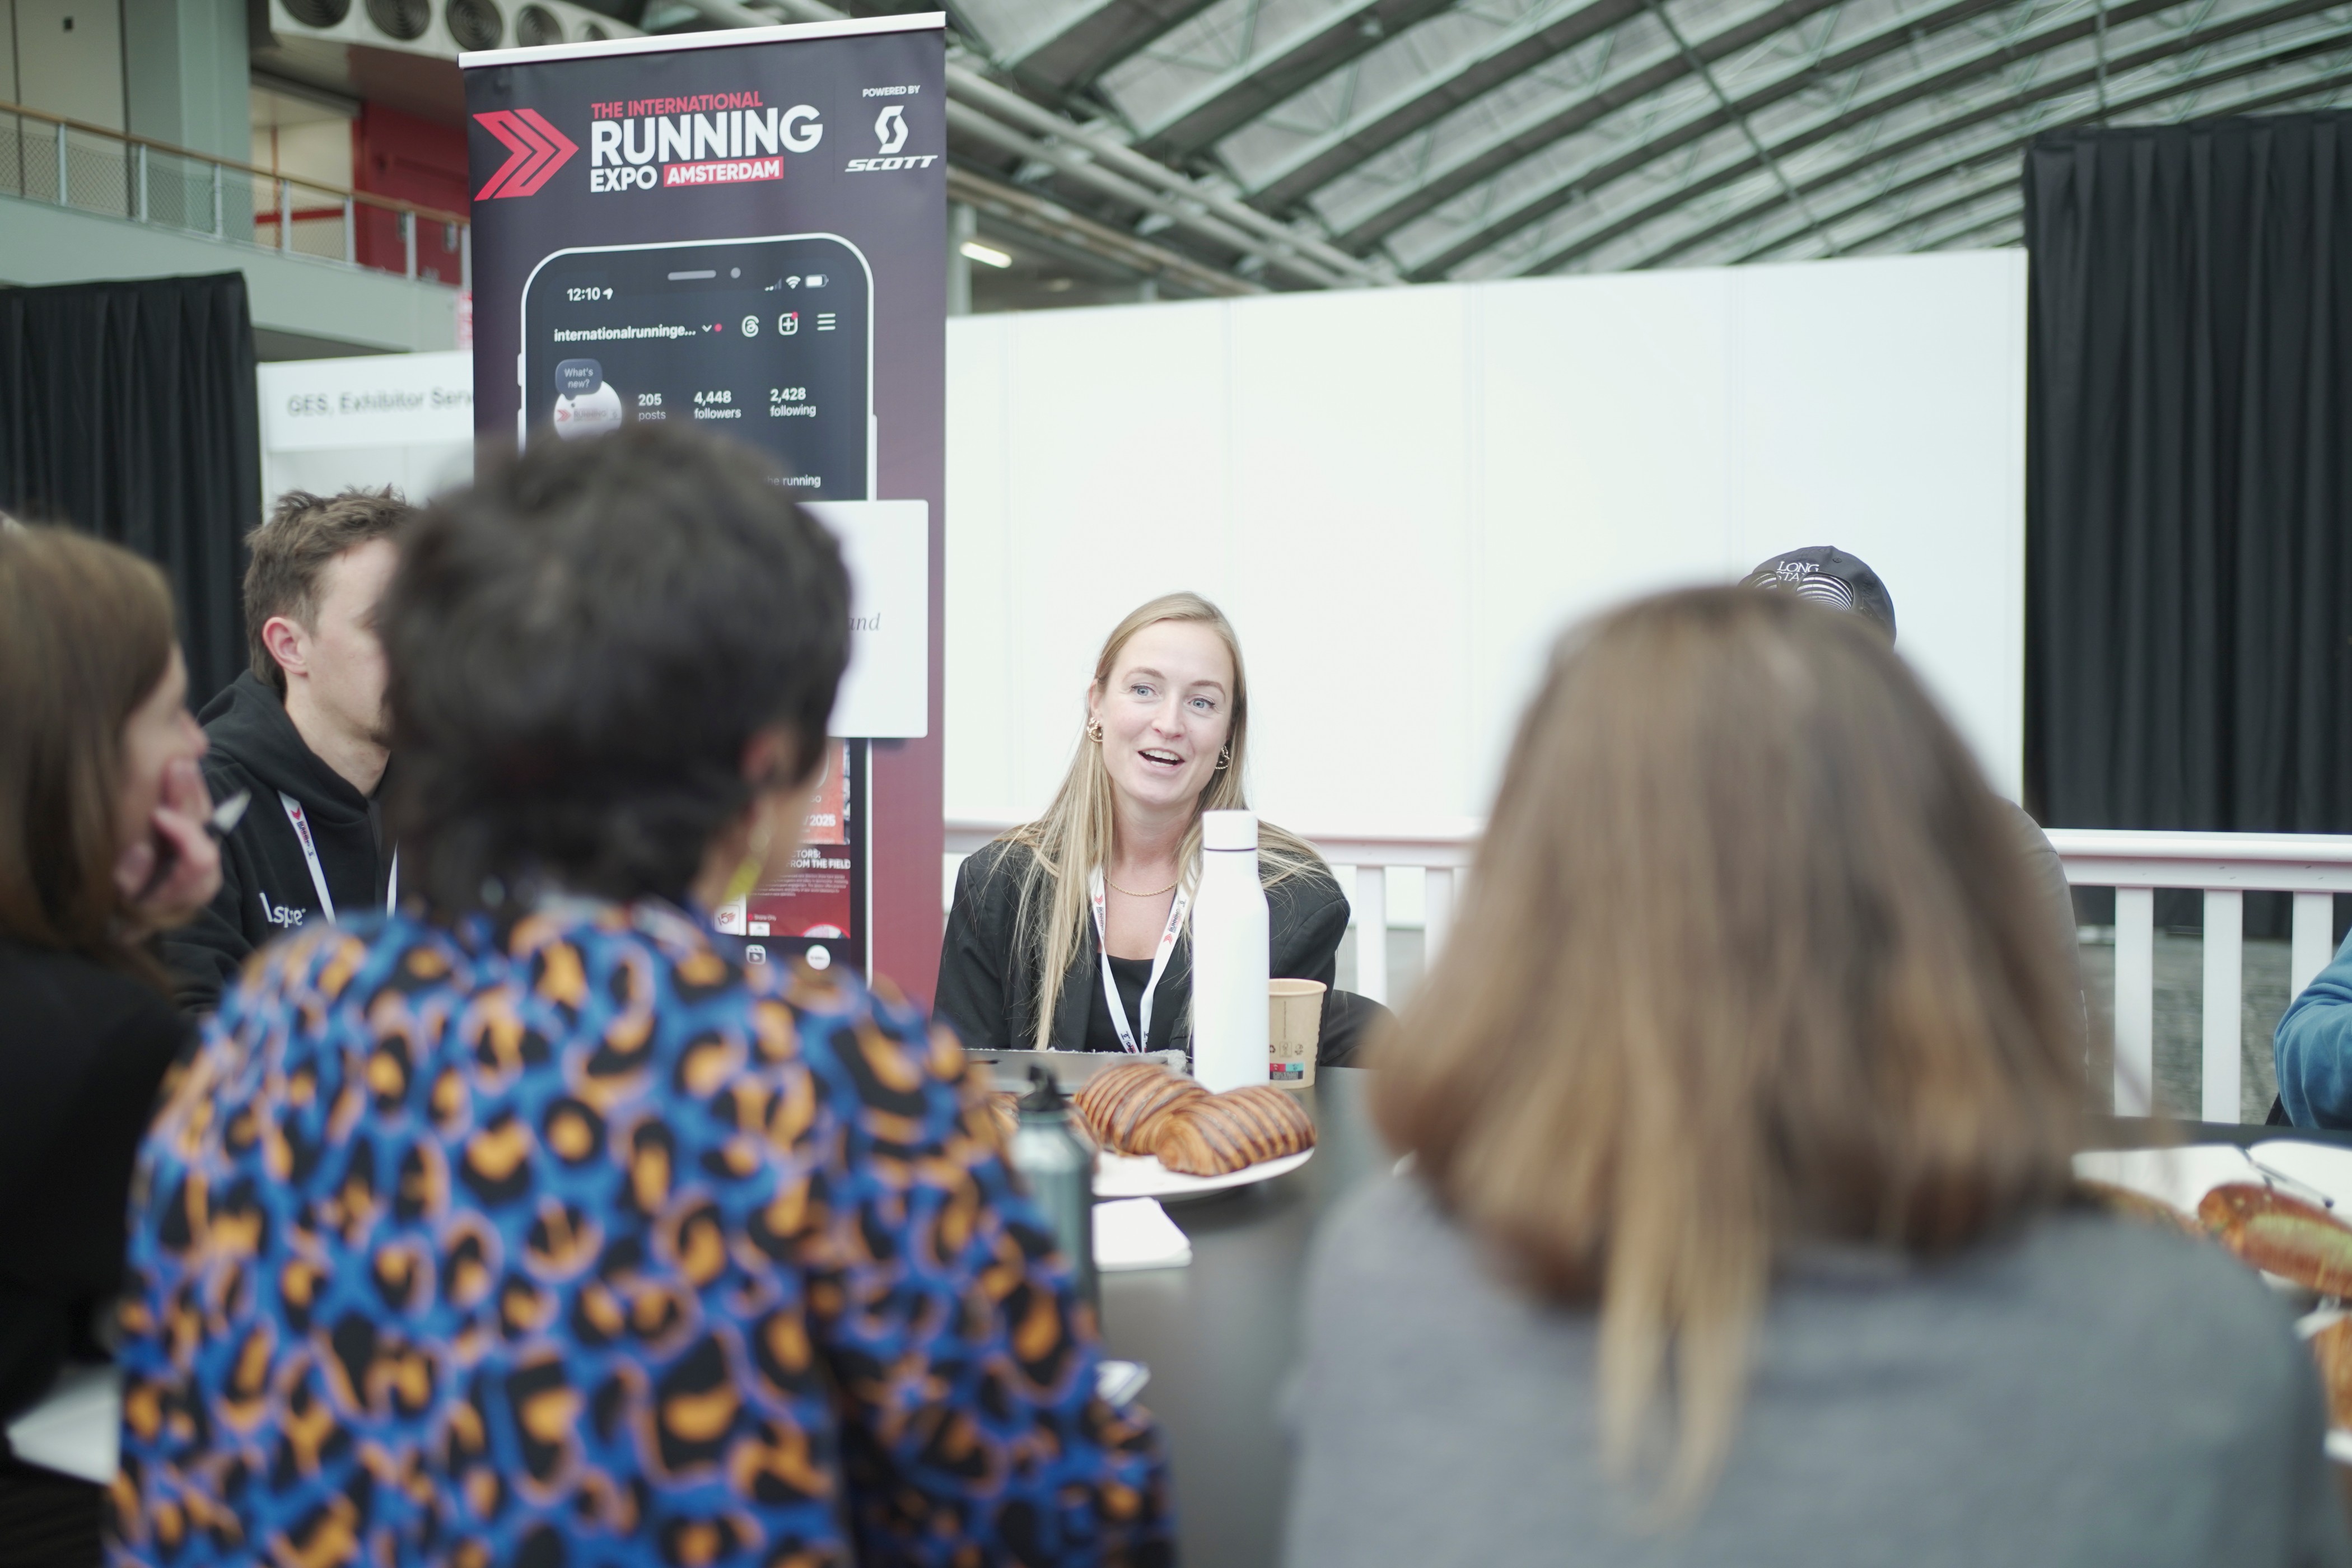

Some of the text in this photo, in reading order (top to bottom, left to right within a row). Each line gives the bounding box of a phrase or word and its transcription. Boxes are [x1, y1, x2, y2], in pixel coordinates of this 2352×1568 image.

[862, 85, 921, 97] POWERED BY
[591, 91, 763, 119] THE INTERNATIONAL
[591, 104, 823, 167] RUNNING
[844, 155, 938, 172] SCOTT
[590, 160, 780, 193] EXPO AMSTERDAM
[567, 287, 600, 301] 12:10
[564, 367, 594, 377] What's
[568, 379, 590, 389] new?
[340, 390, 424, 414] Exhibitor
[638, 393, 662, 406] 205
[694, 390, 731, 407] 4,448
[770, 388, 806, 404] 2,428
[638, 409, 666, 421] posts
[694, 407, 741, 419] followers
[770, 404, 816, 417] following
[764, 474, 821, 488] he running
[1776, 561, 1819, 573] LONG
[810, 814, 836, 827] 2025
[811, 858, 827, 869] THE
[829, 858, 851, 870] FIELD
